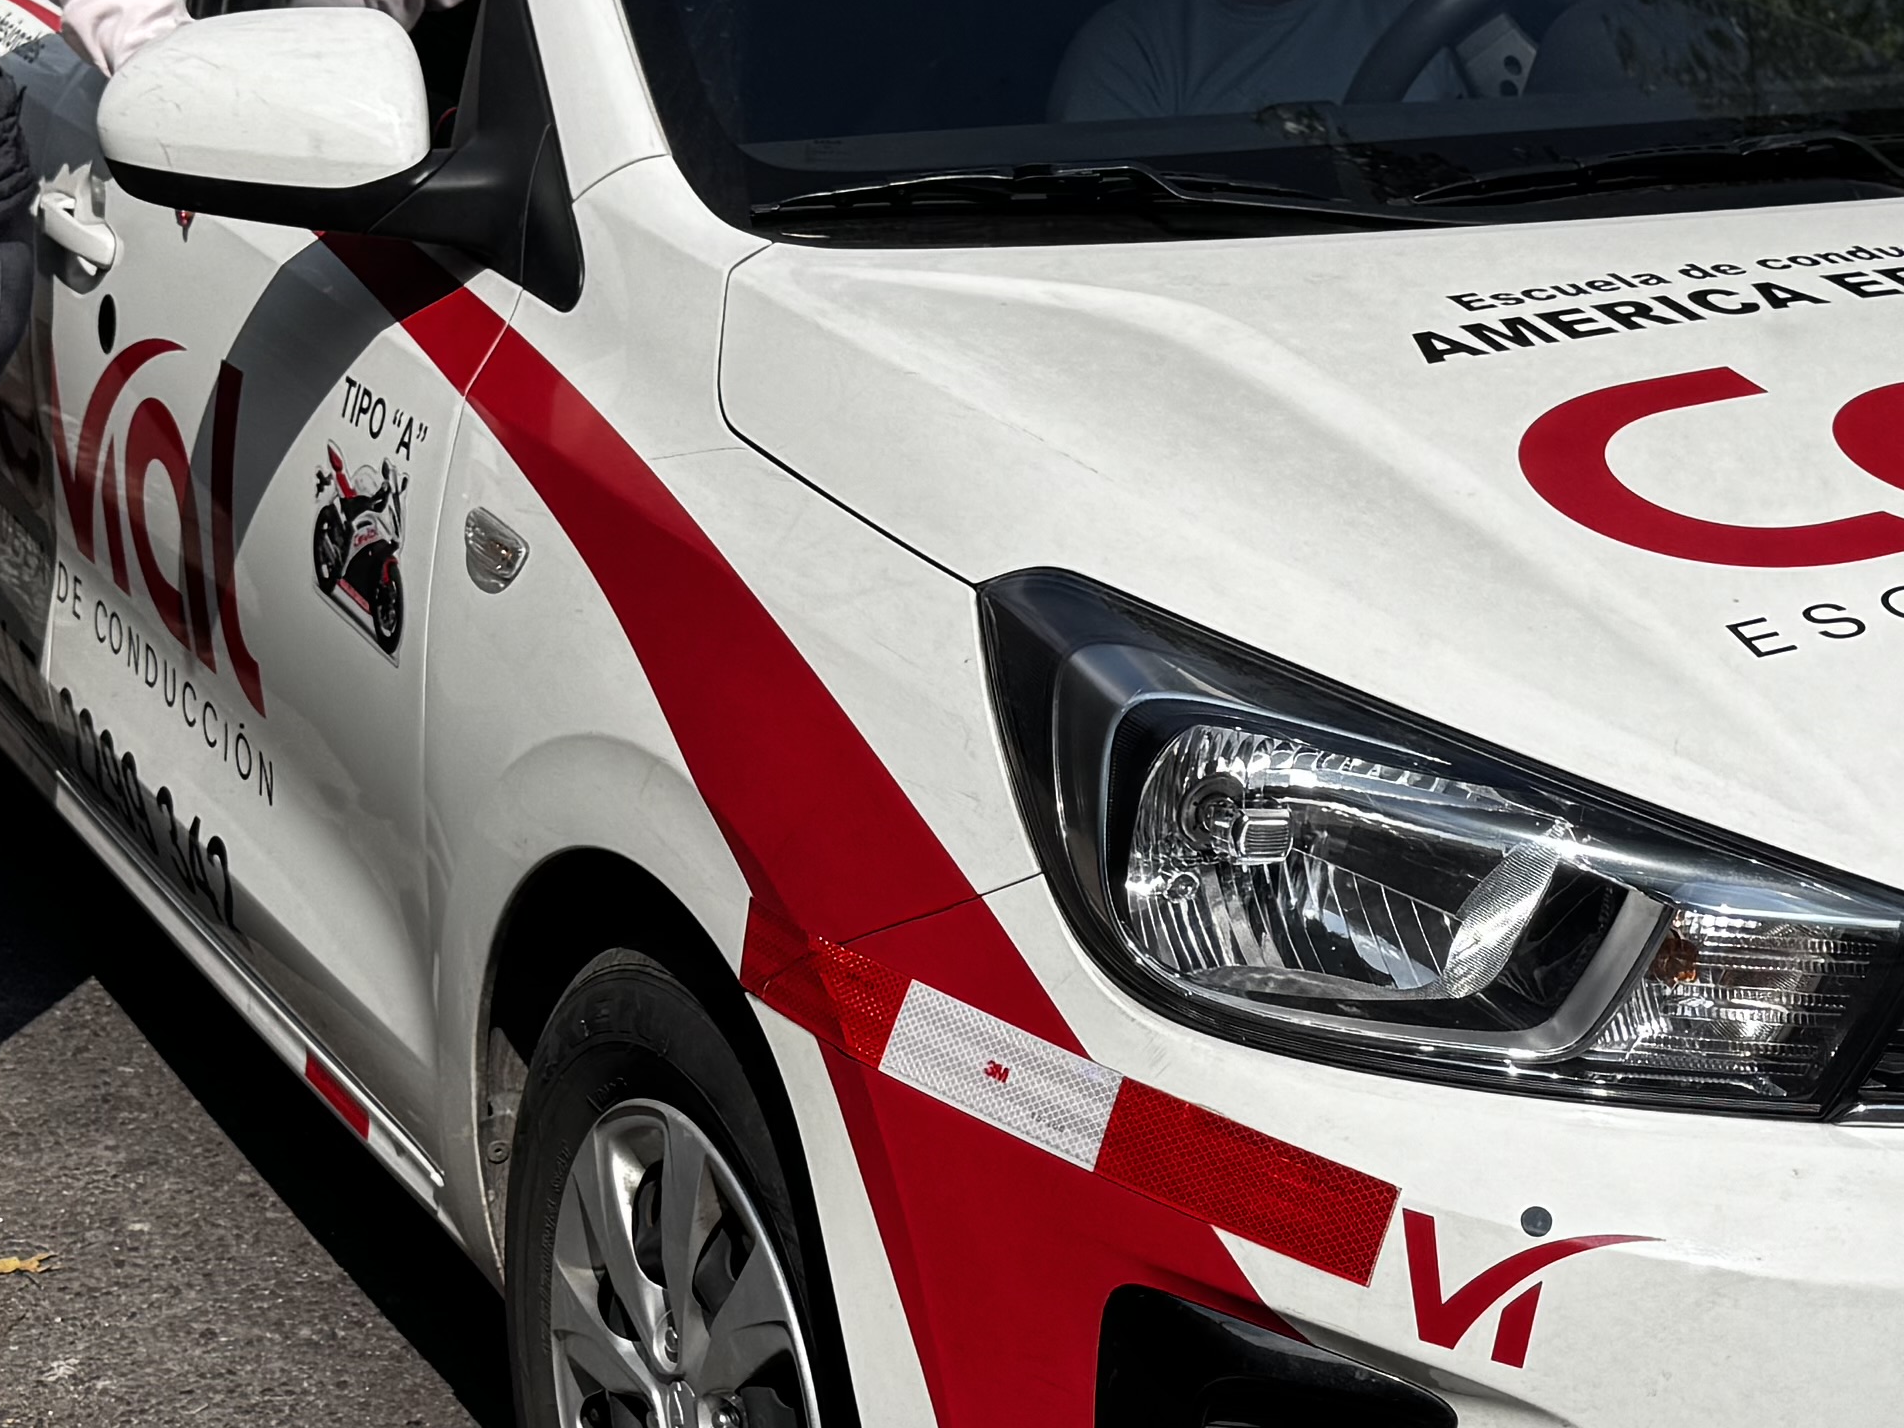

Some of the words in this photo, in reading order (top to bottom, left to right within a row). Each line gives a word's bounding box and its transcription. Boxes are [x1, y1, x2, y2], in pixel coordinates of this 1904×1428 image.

[1445, 271, 1673, 313] Escuela
[1677, 262, 1747, 280] de
[1411, 281, 1832, 365] AMERICA
[341, 376, 386, 440] TIPO
[58, 560, 82, 621] DE
[94, 599, 275, 808] CONDUCCIÓN
[983, 1060, 1010, 1084] 3M
